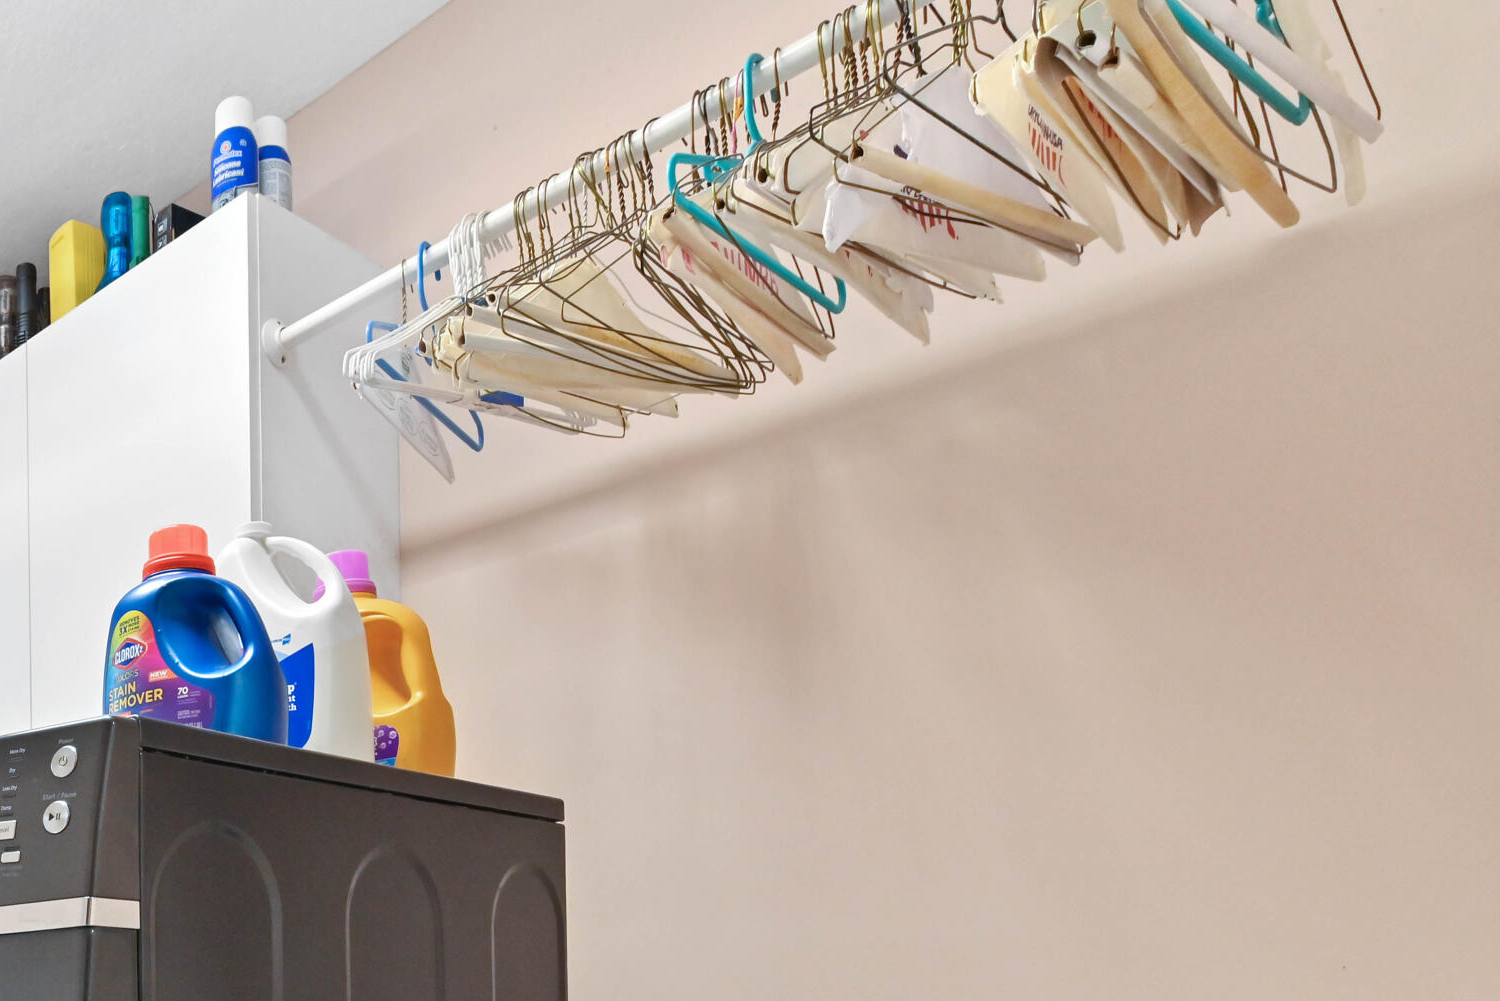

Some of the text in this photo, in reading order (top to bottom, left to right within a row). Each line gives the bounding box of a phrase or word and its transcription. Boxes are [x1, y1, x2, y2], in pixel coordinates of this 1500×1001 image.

[150, 670, 168, 678] NEW
[109, 681, 137, 701] STAIN
[177, 686, 188, 696] 70
[109, 688, 163, 714] REMOVER
